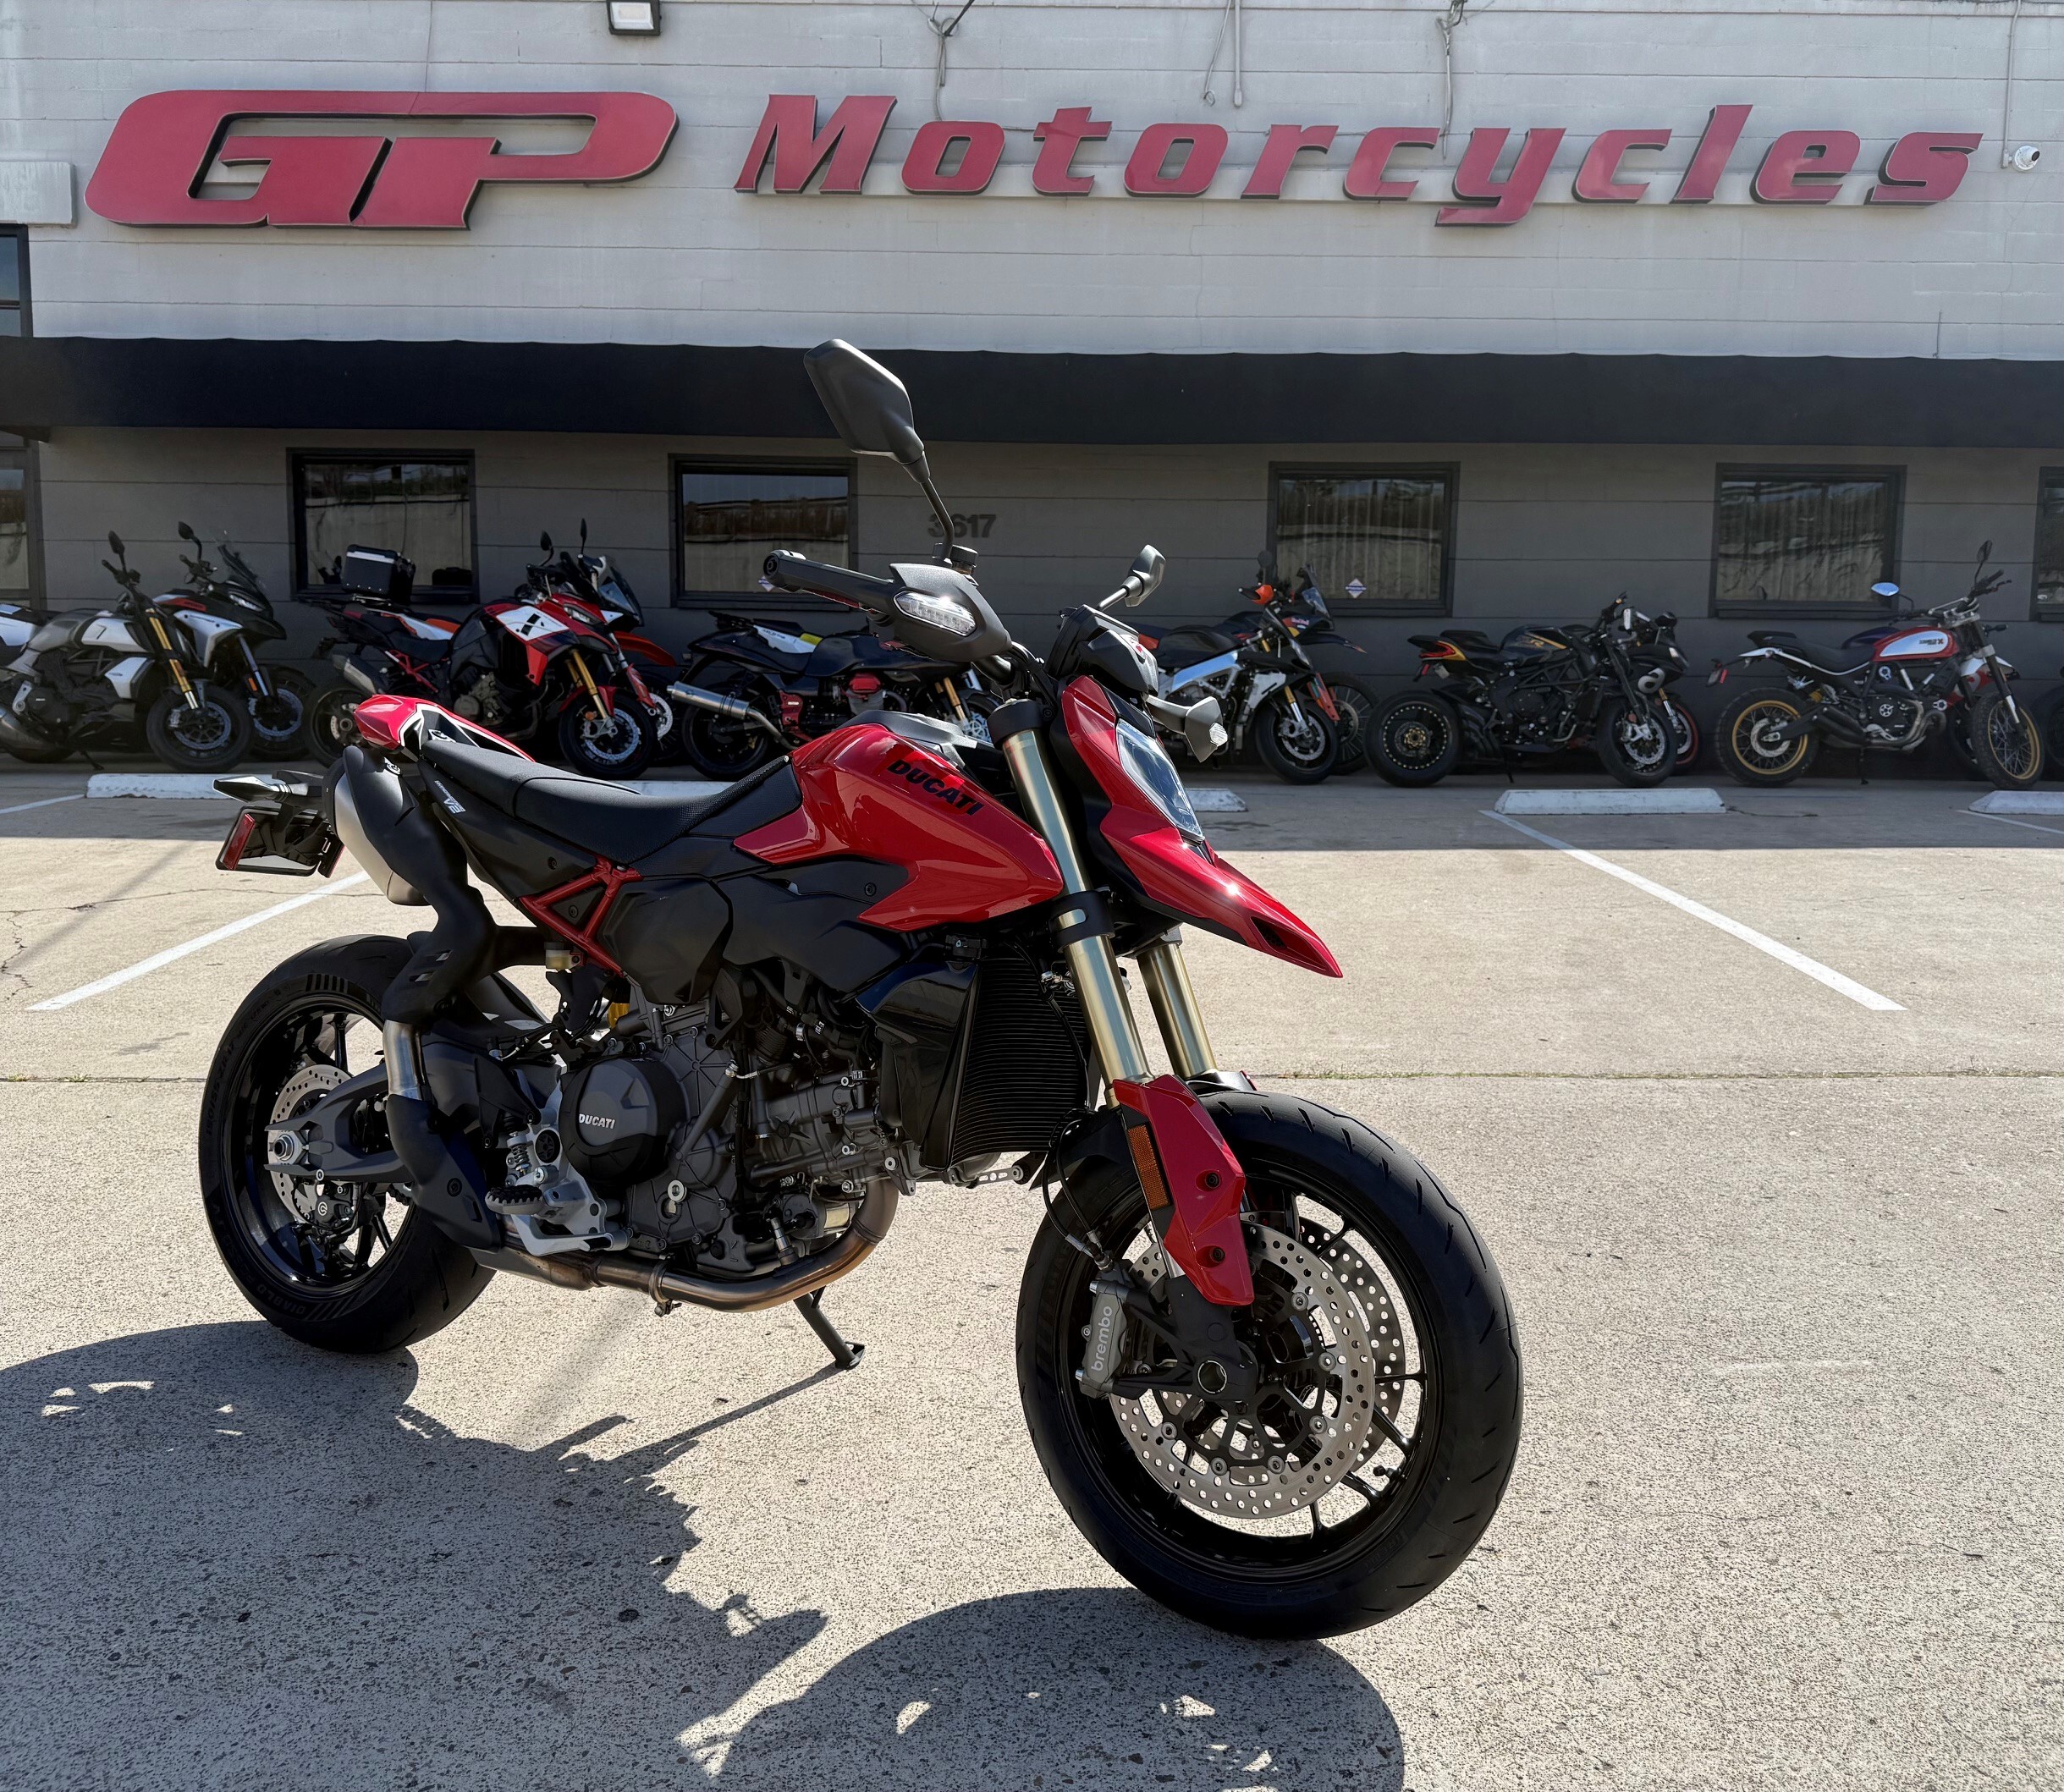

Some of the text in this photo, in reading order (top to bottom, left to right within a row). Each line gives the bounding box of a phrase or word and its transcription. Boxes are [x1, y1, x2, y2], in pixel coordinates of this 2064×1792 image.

[85, 90, 1984, 230] GP Motorcycles
[887, 759, 984, 816] DUCATI
[579, 1113, 615, 1130] DUCATI
[1091, 1306, 1113, 1371] brembo
